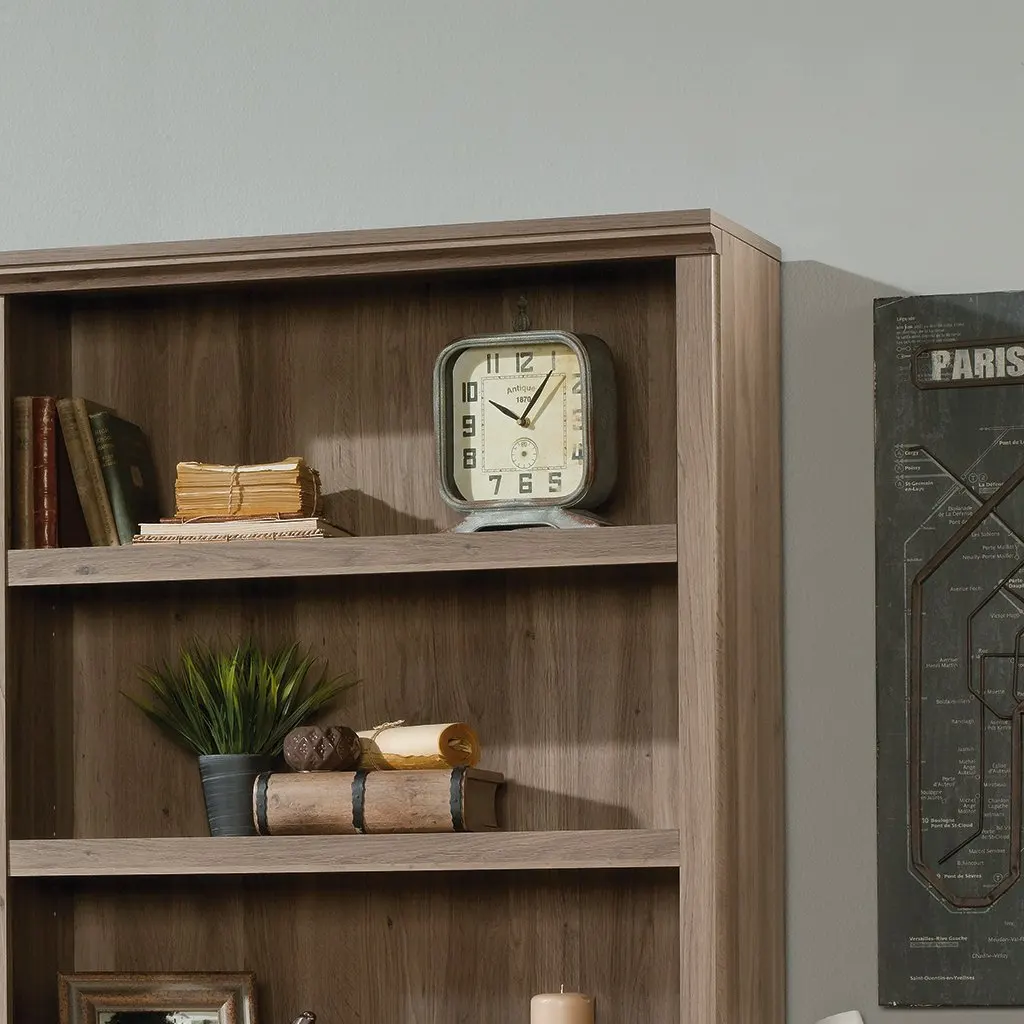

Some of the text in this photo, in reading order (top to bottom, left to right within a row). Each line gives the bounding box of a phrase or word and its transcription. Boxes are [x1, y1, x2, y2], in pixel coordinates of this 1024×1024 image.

[487, 353, 499, 373] 11
[516, 352, 533, 372] 12
[931, 345, 1024, 381] PARIS
[462, 382, 477, 402] 10
[506, 384, 535, 395] Antique
[463, 415, 475, 437] 9
[463, 448, 476, 468] 8
[489, 475, 502, 495] 7
[519, 473, 532, 493] 6
[549, 472, 562, 492] 5
